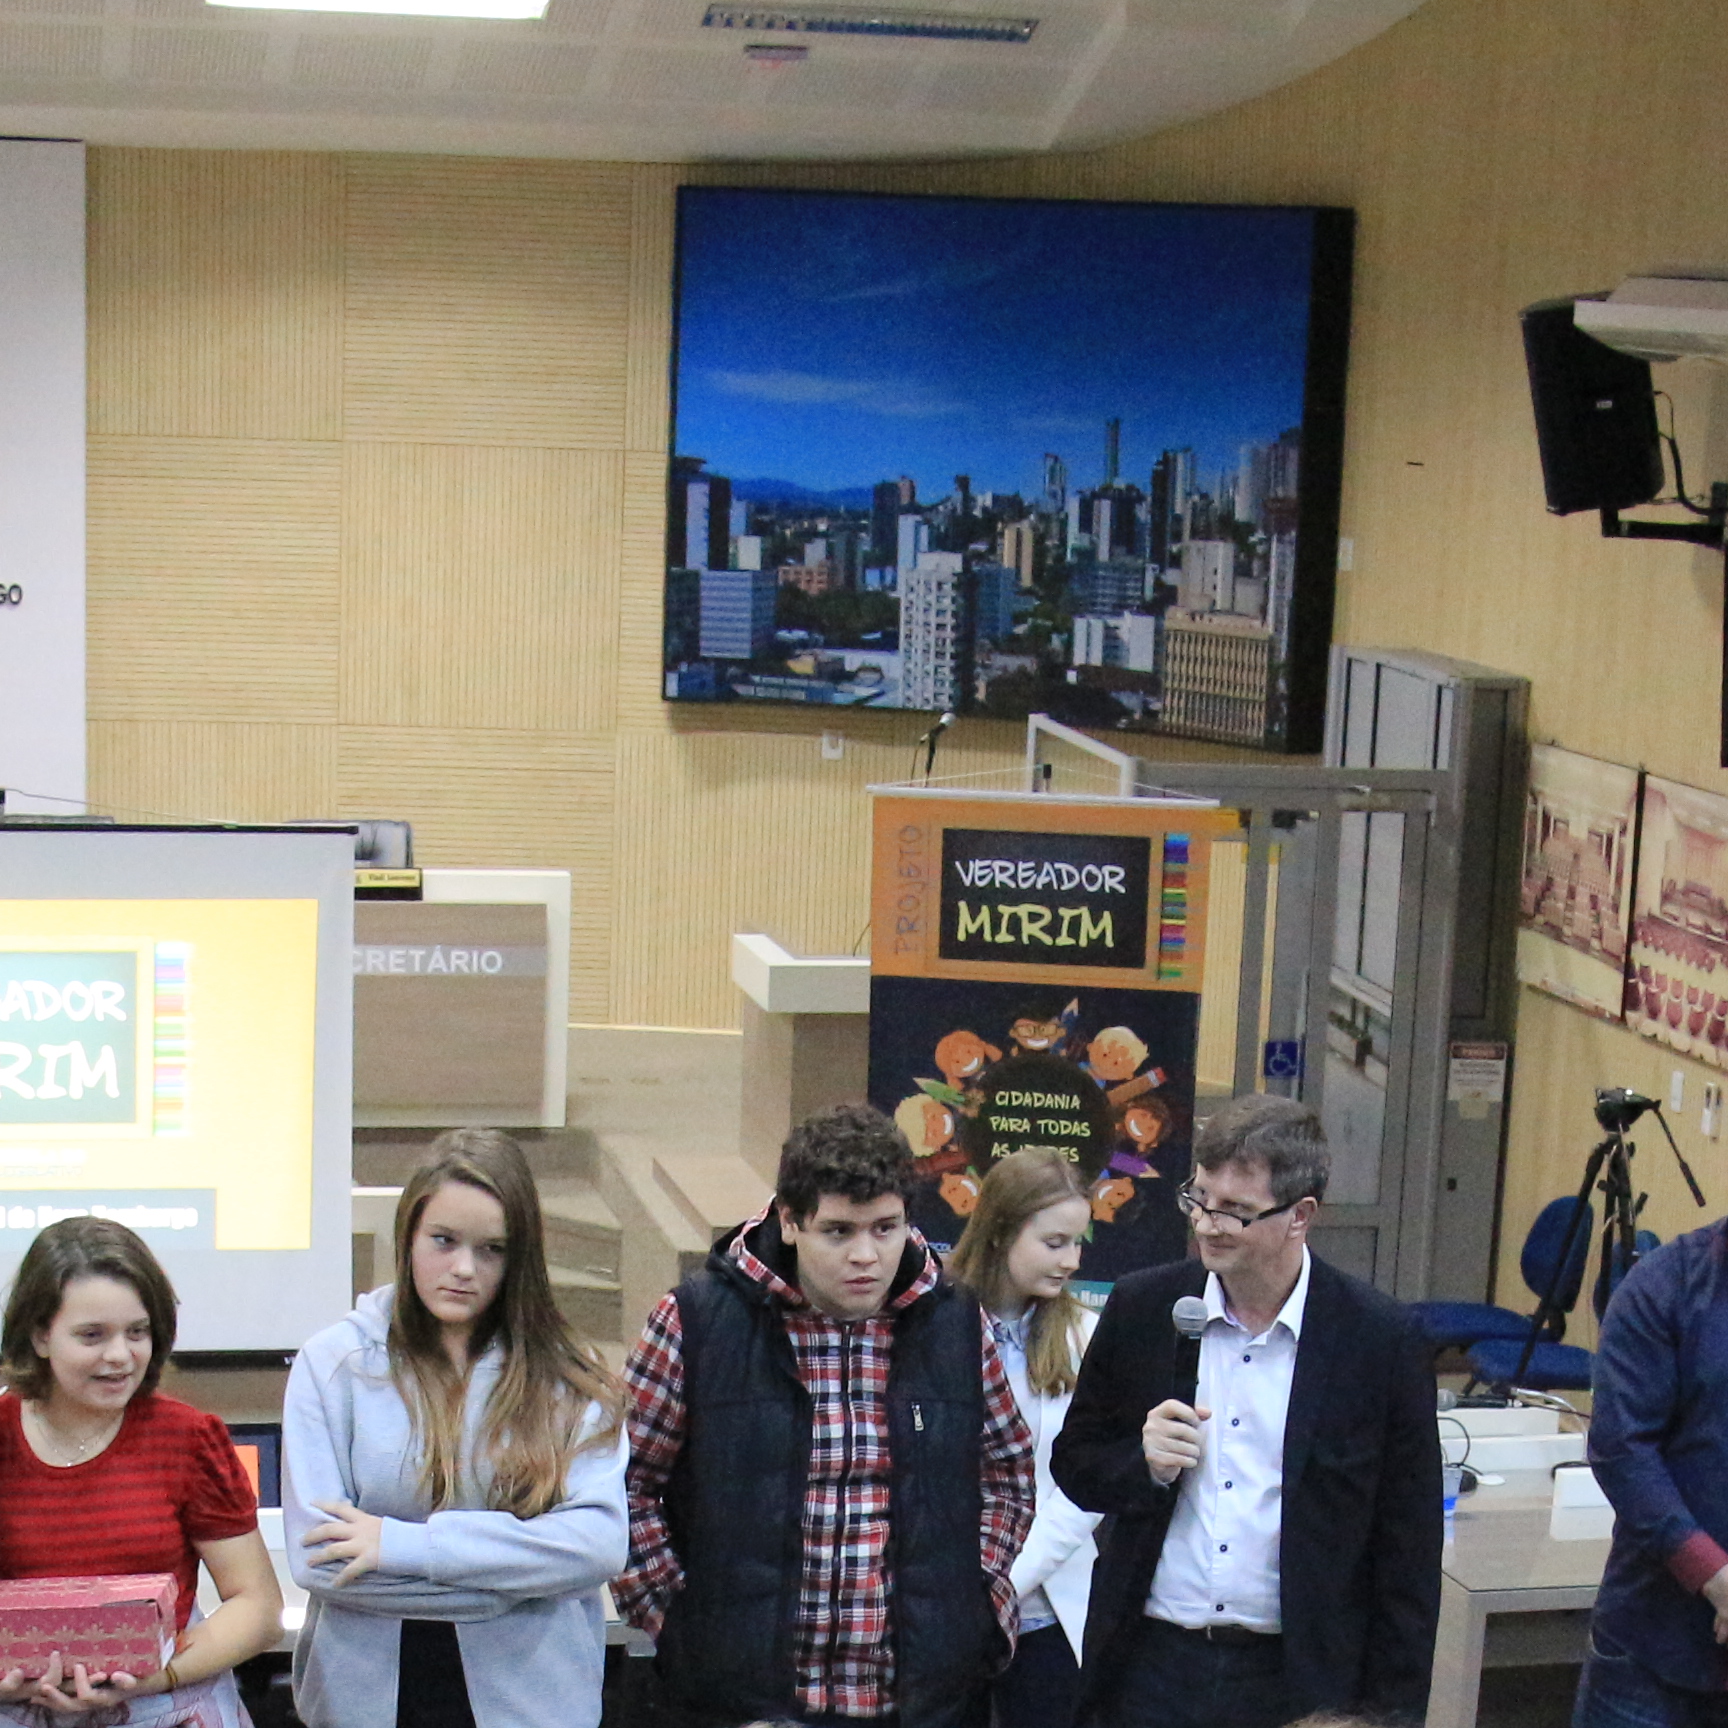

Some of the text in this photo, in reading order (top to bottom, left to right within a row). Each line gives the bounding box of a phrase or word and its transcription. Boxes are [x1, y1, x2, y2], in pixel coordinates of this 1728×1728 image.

[893, 825, 924, 955] PROJETO
[955, 858, 1127, 894] VEREADOR
[957, 900, 1115, 948] MIRIM
[995, 1090, 1081, 1110] CIDADANIA
[989, 1115, 1091, 1137] PARA TODAS
